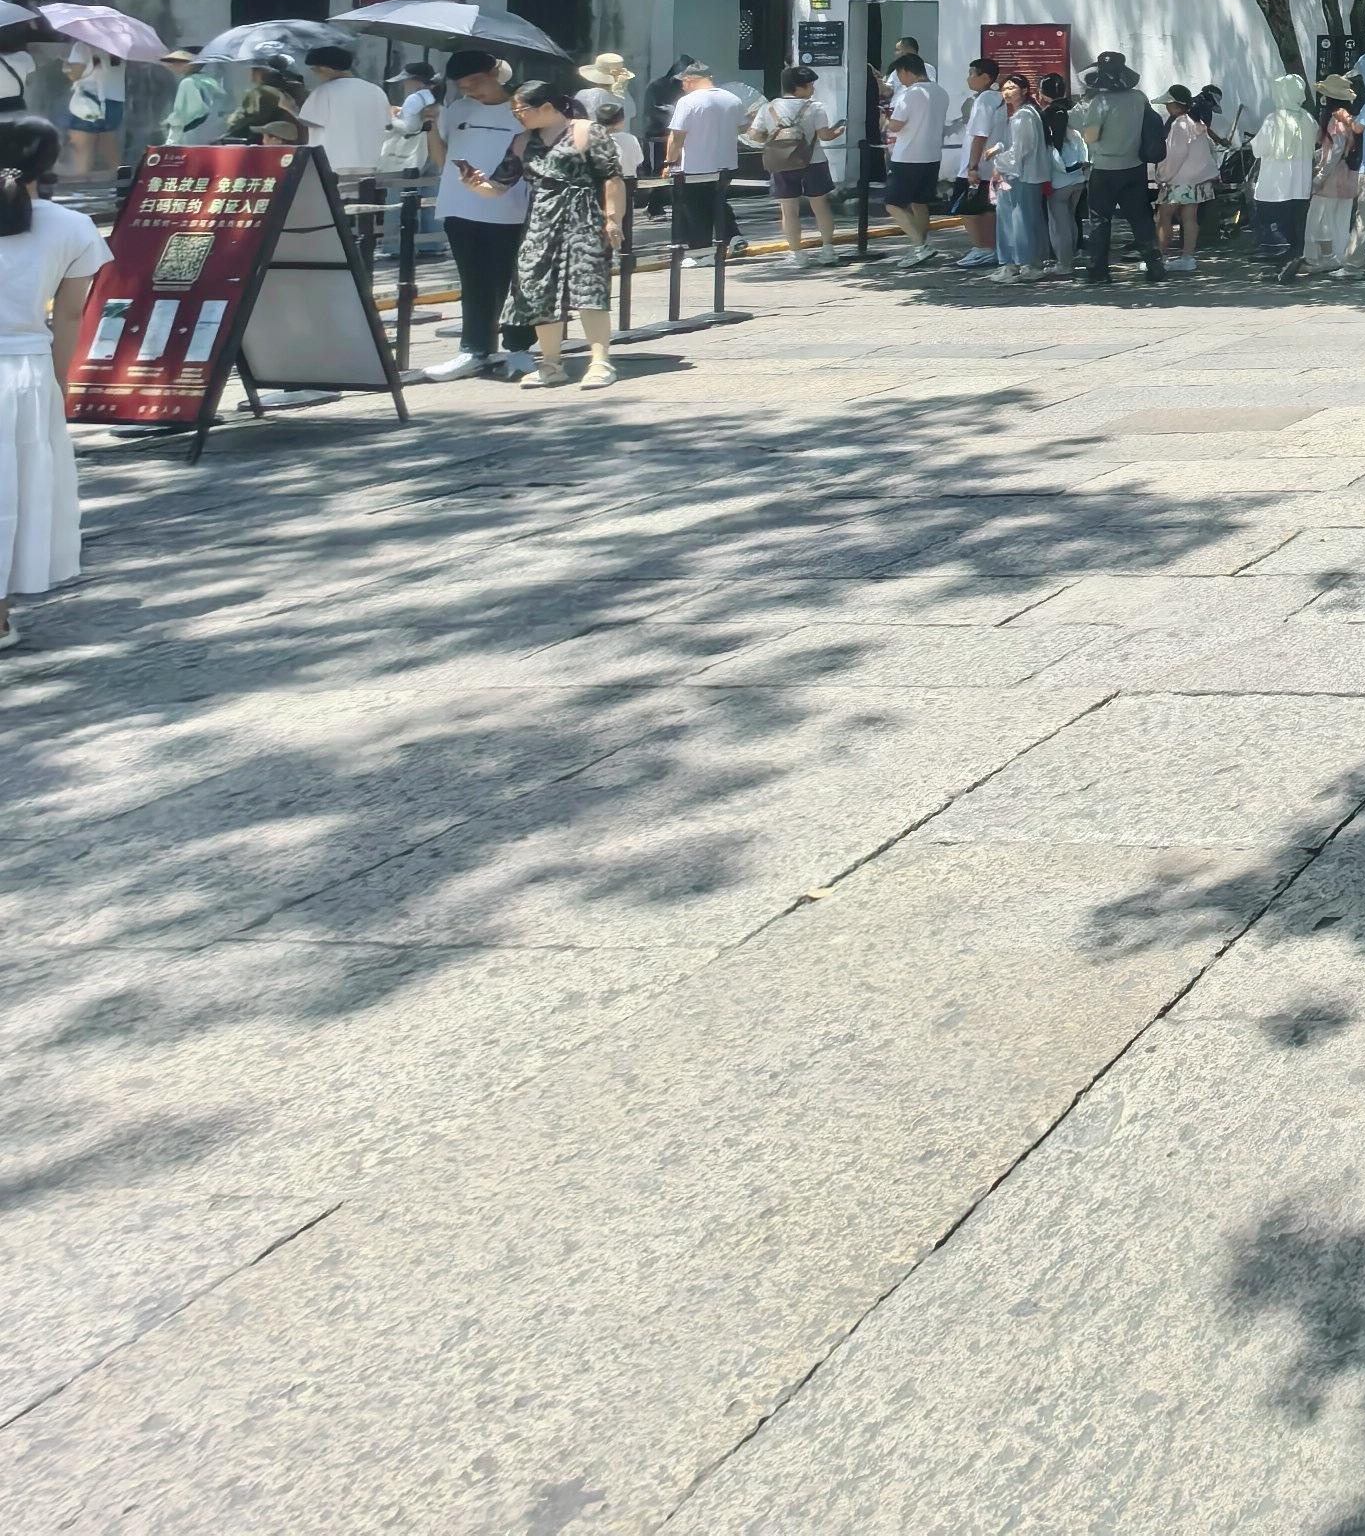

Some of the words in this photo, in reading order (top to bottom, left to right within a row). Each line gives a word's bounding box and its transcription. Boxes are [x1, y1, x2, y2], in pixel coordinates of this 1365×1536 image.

[147, 177, 210, 193] 鲁迅故里
[214, 177, 277, 193] 免费开放
[139, 198, 203, 214] 扫码预约
